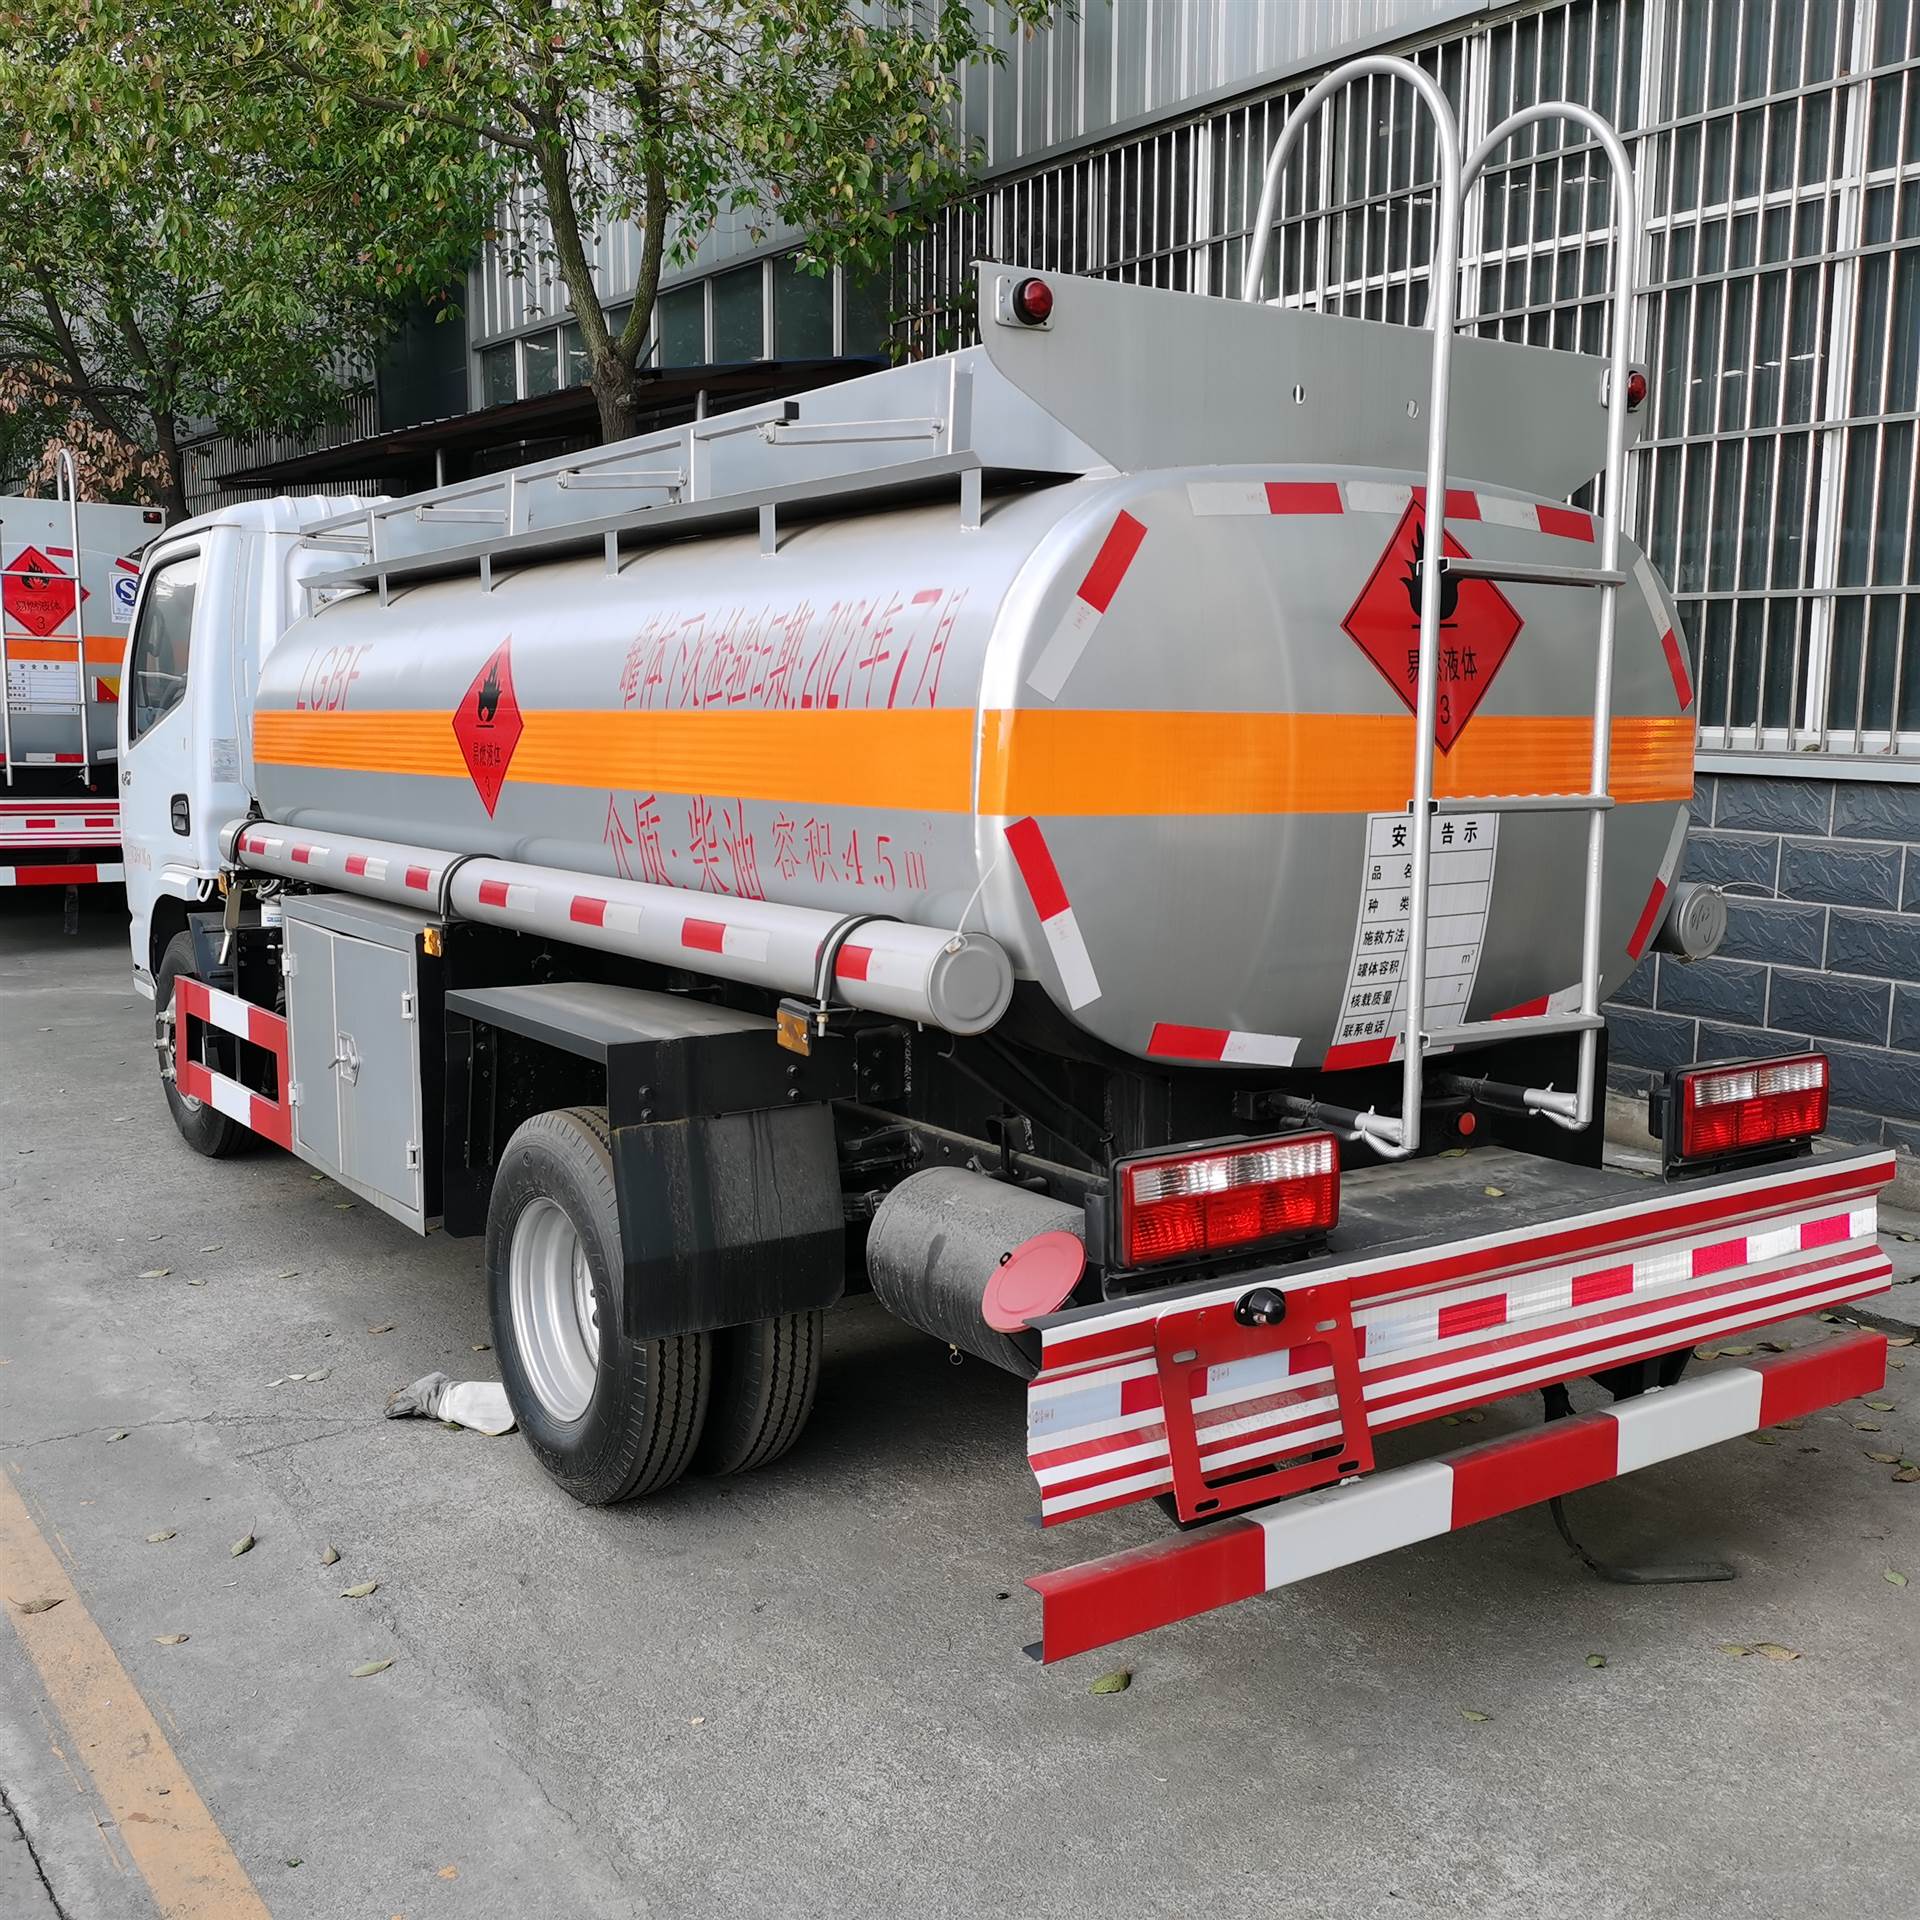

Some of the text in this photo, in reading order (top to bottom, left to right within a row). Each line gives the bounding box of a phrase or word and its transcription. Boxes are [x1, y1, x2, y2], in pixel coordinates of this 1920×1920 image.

[36, 615, 46, 630] 3
[1440, 694, 1450, 725] 3
[1391, 822, 1479, 848] 安告示
[1362, 928, 1405, 946] 施救方法
[1357, 960, 1400, 978] 罐体容积
[1350, 983, 1464, 1009] 核载质量 T
[1342, 1020, 1386, 1038] 联系电话
